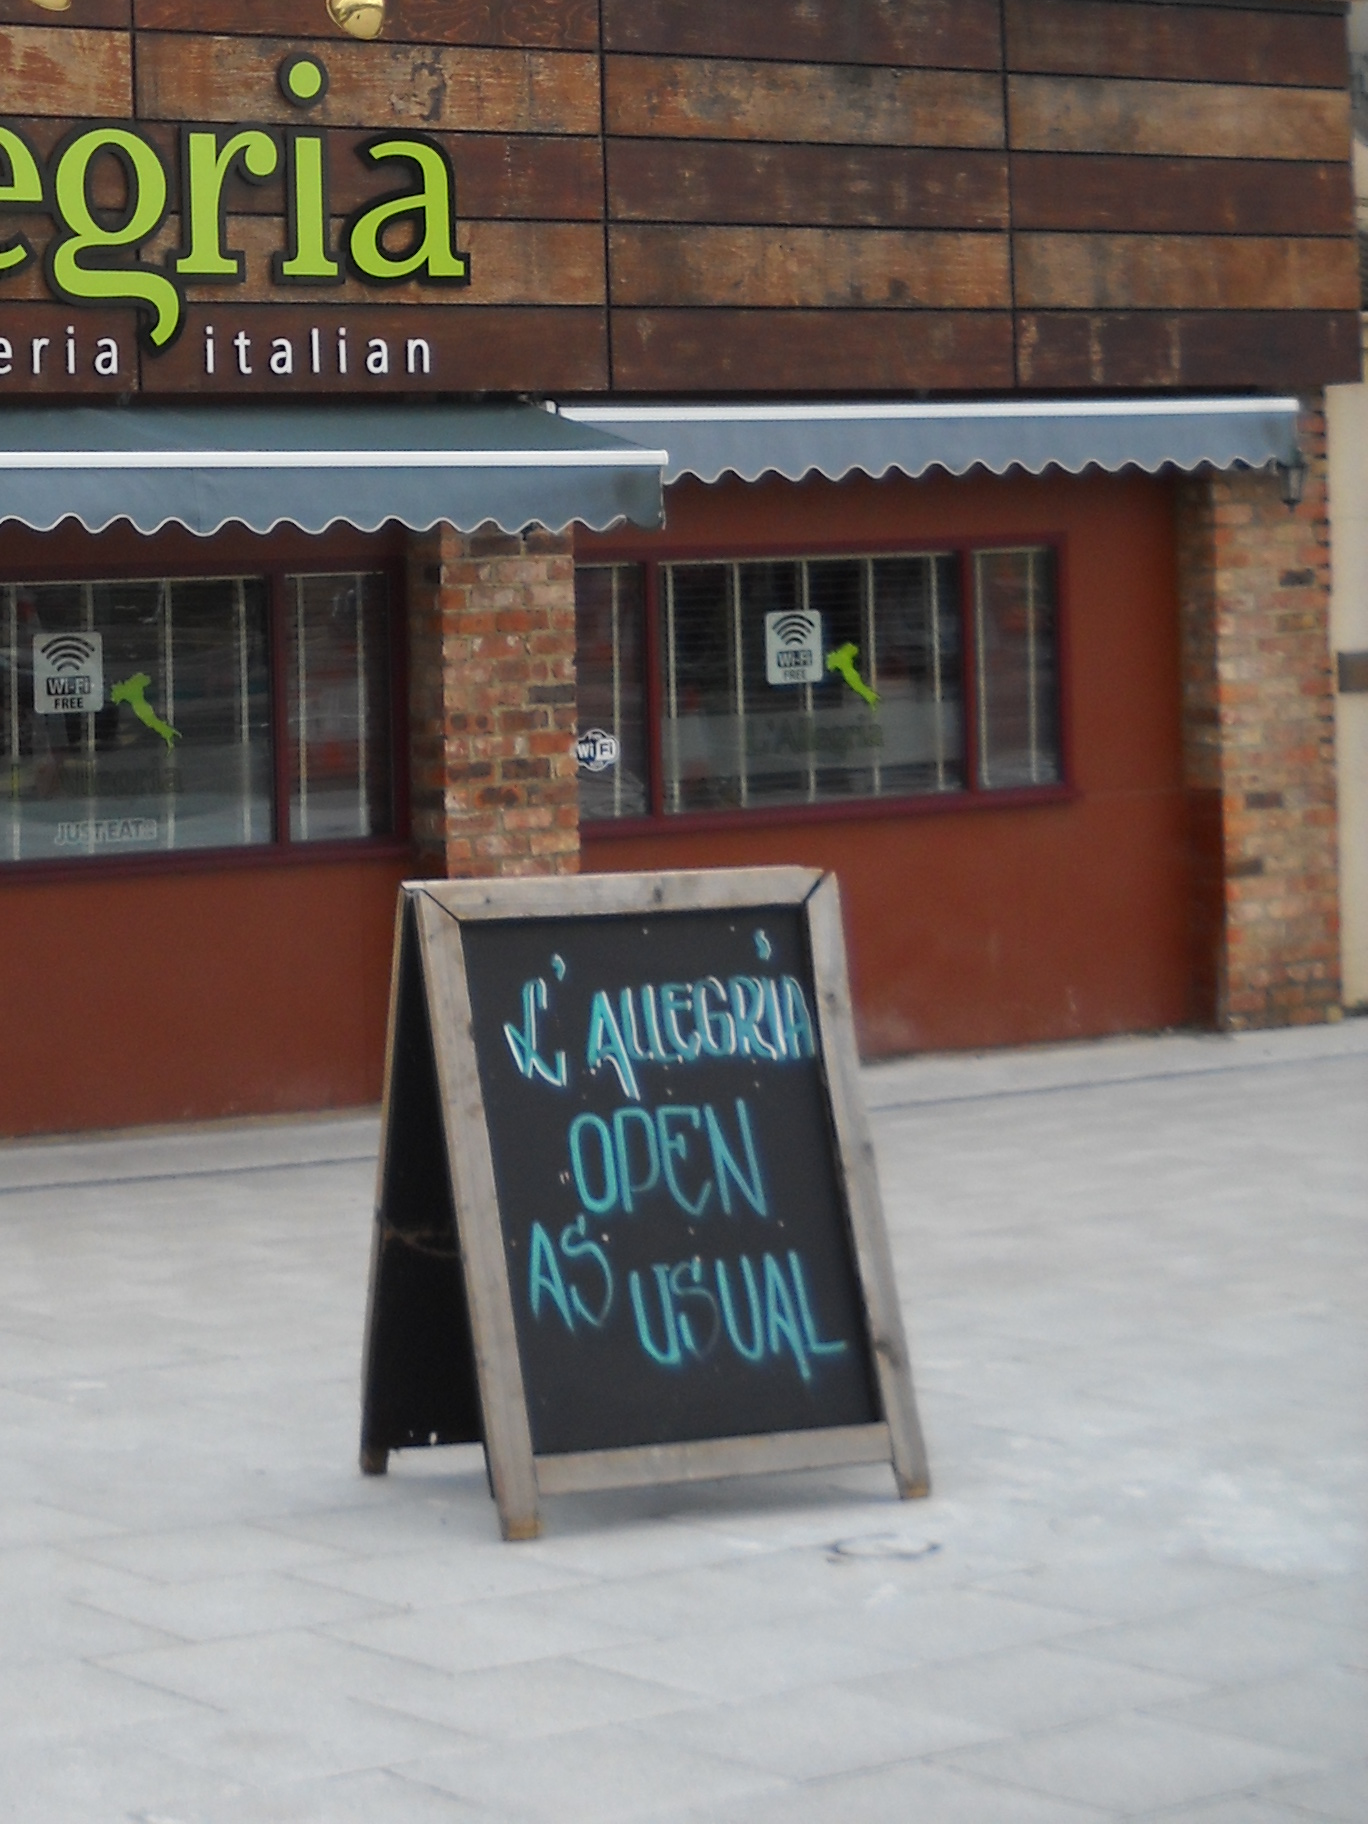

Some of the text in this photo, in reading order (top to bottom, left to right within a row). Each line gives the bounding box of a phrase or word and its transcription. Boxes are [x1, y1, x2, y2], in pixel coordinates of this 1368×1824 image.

[205, 326, 432, 374] italian
[54, 698, 83, 709] FREE
[569, 1098, 770, 1217] OPEN
[528, 1216, 848, 1382] AS USUAL
